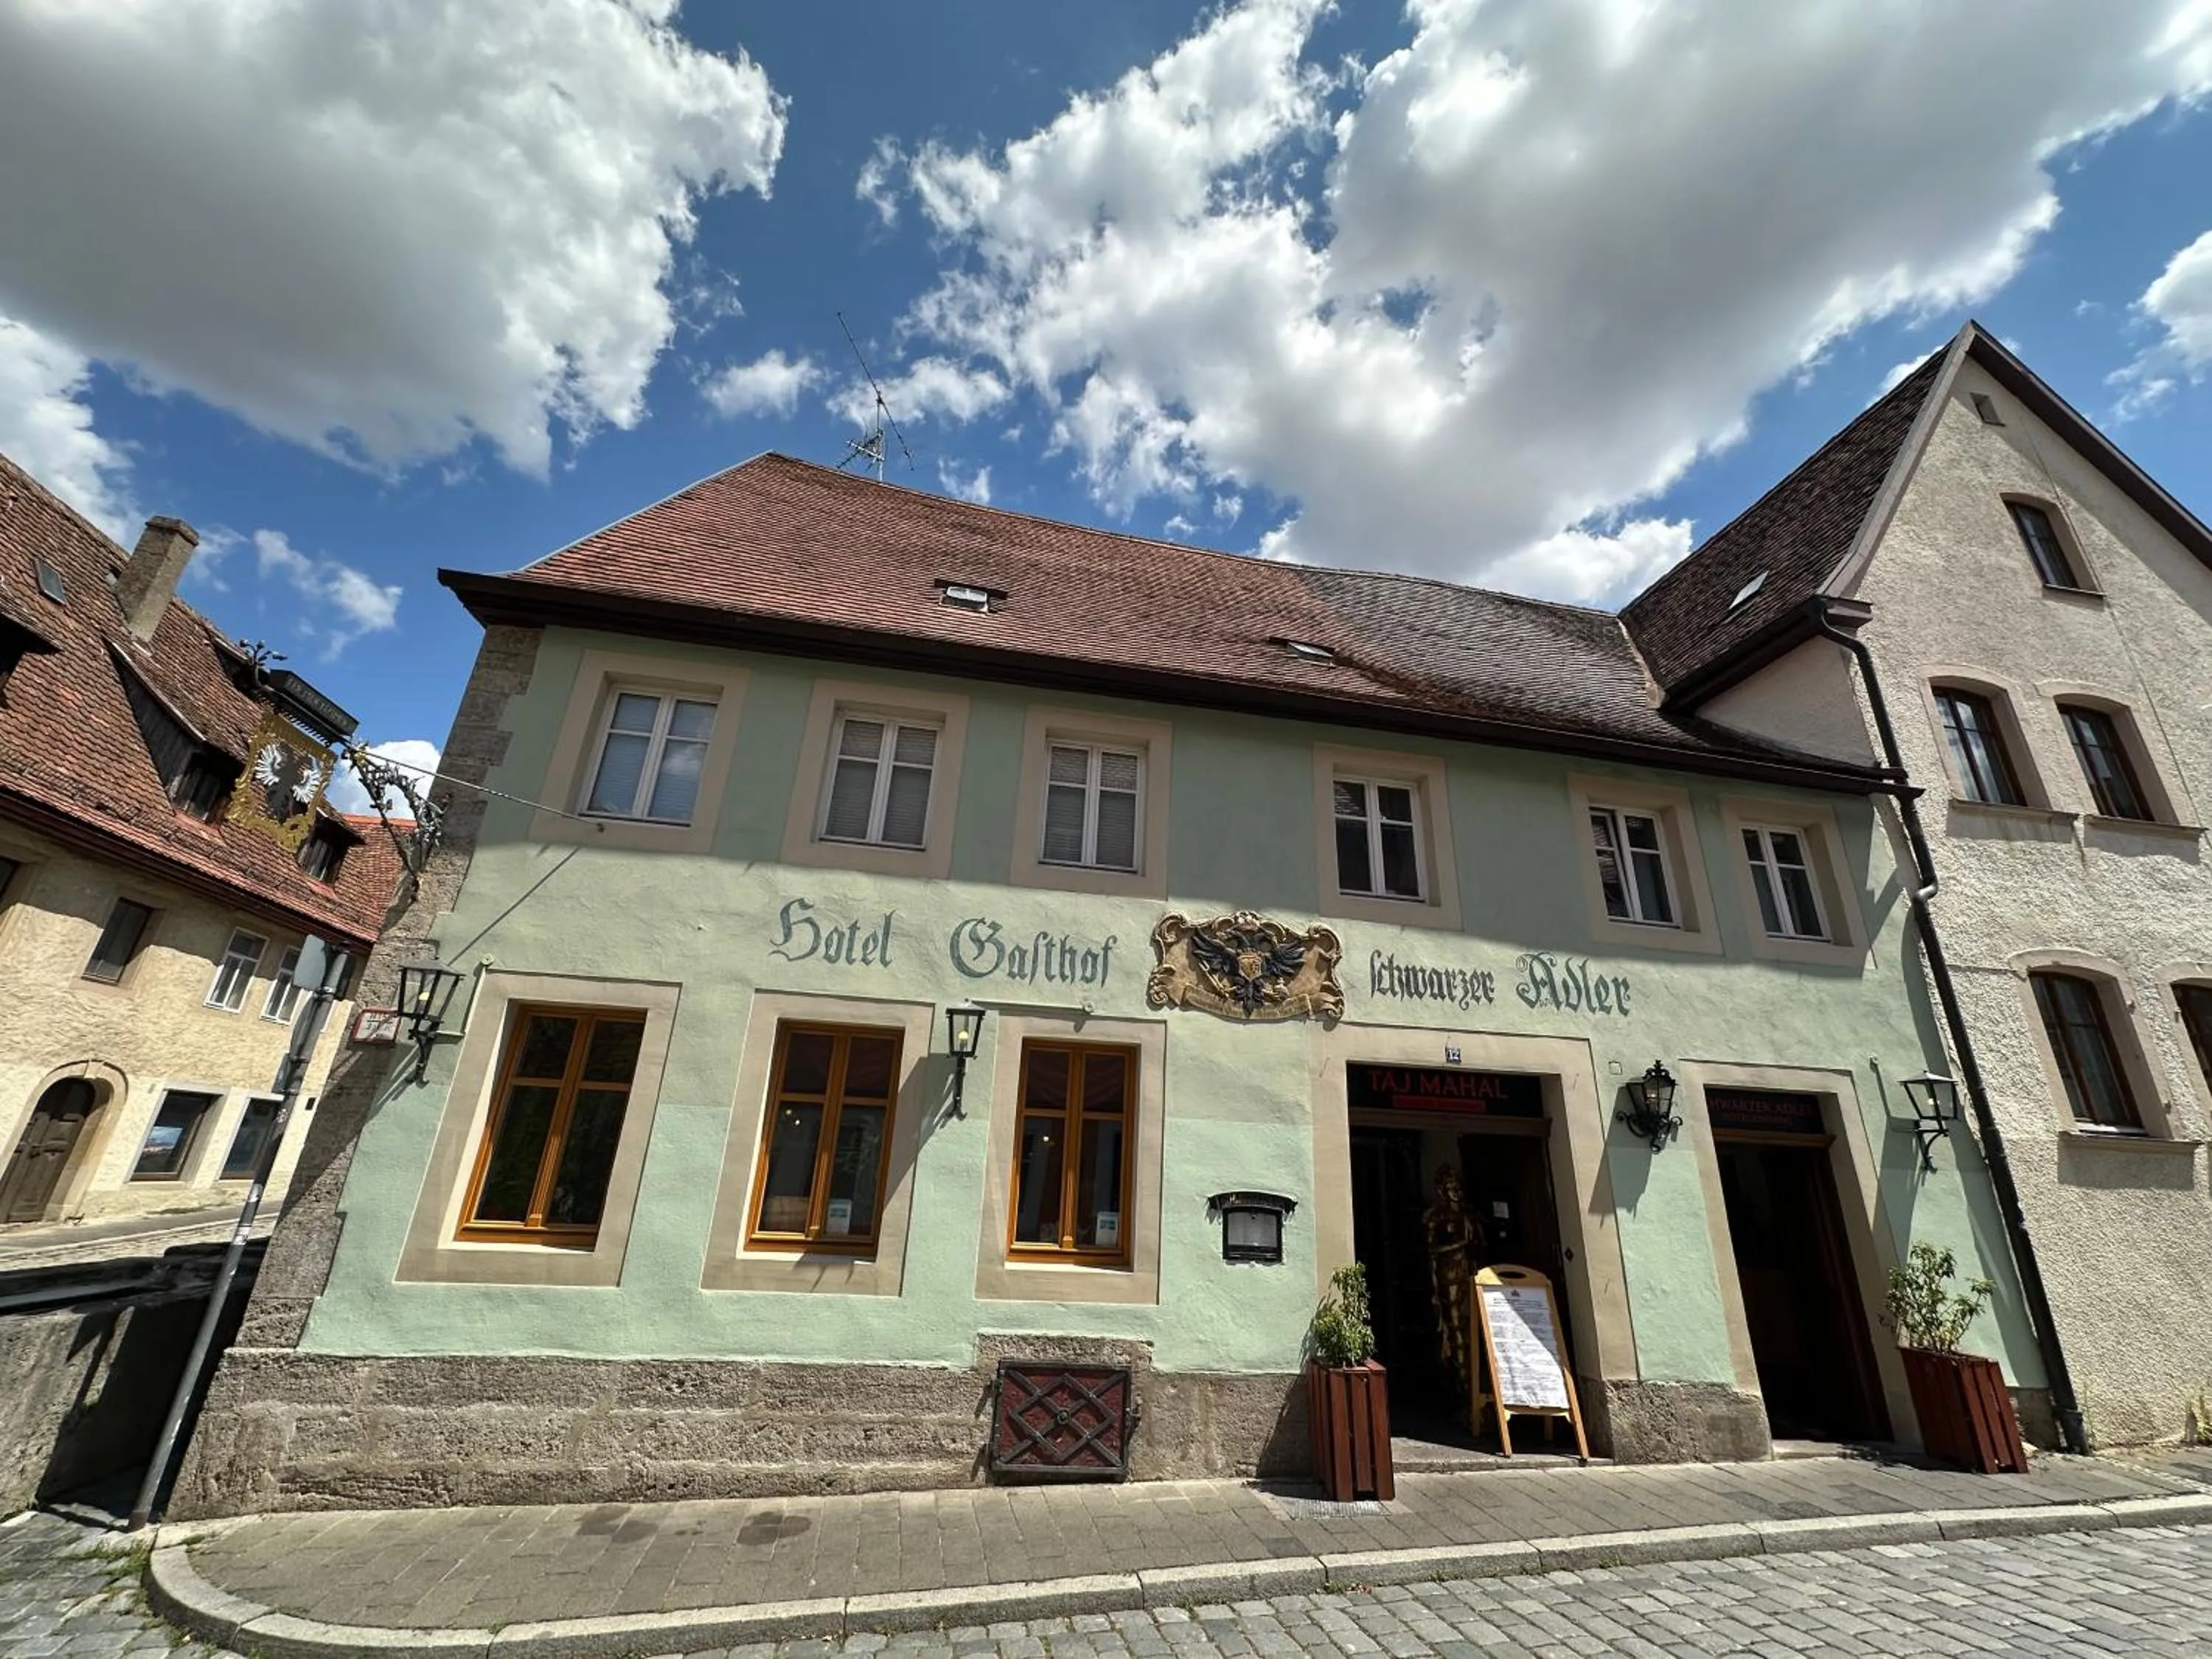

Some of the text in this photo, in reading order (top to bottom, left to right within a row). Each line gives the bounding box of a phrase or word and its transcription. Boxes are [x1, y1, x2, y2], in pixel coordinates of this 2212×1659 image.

[768, 897, 1118, 988] Hotel Gasthof
[1369, 949, 1495, 1011] schwarzer
[1515, 951, 1631, 1018] Adler
[1366, 1068, 1509, 1099] TAJ MAHAL
